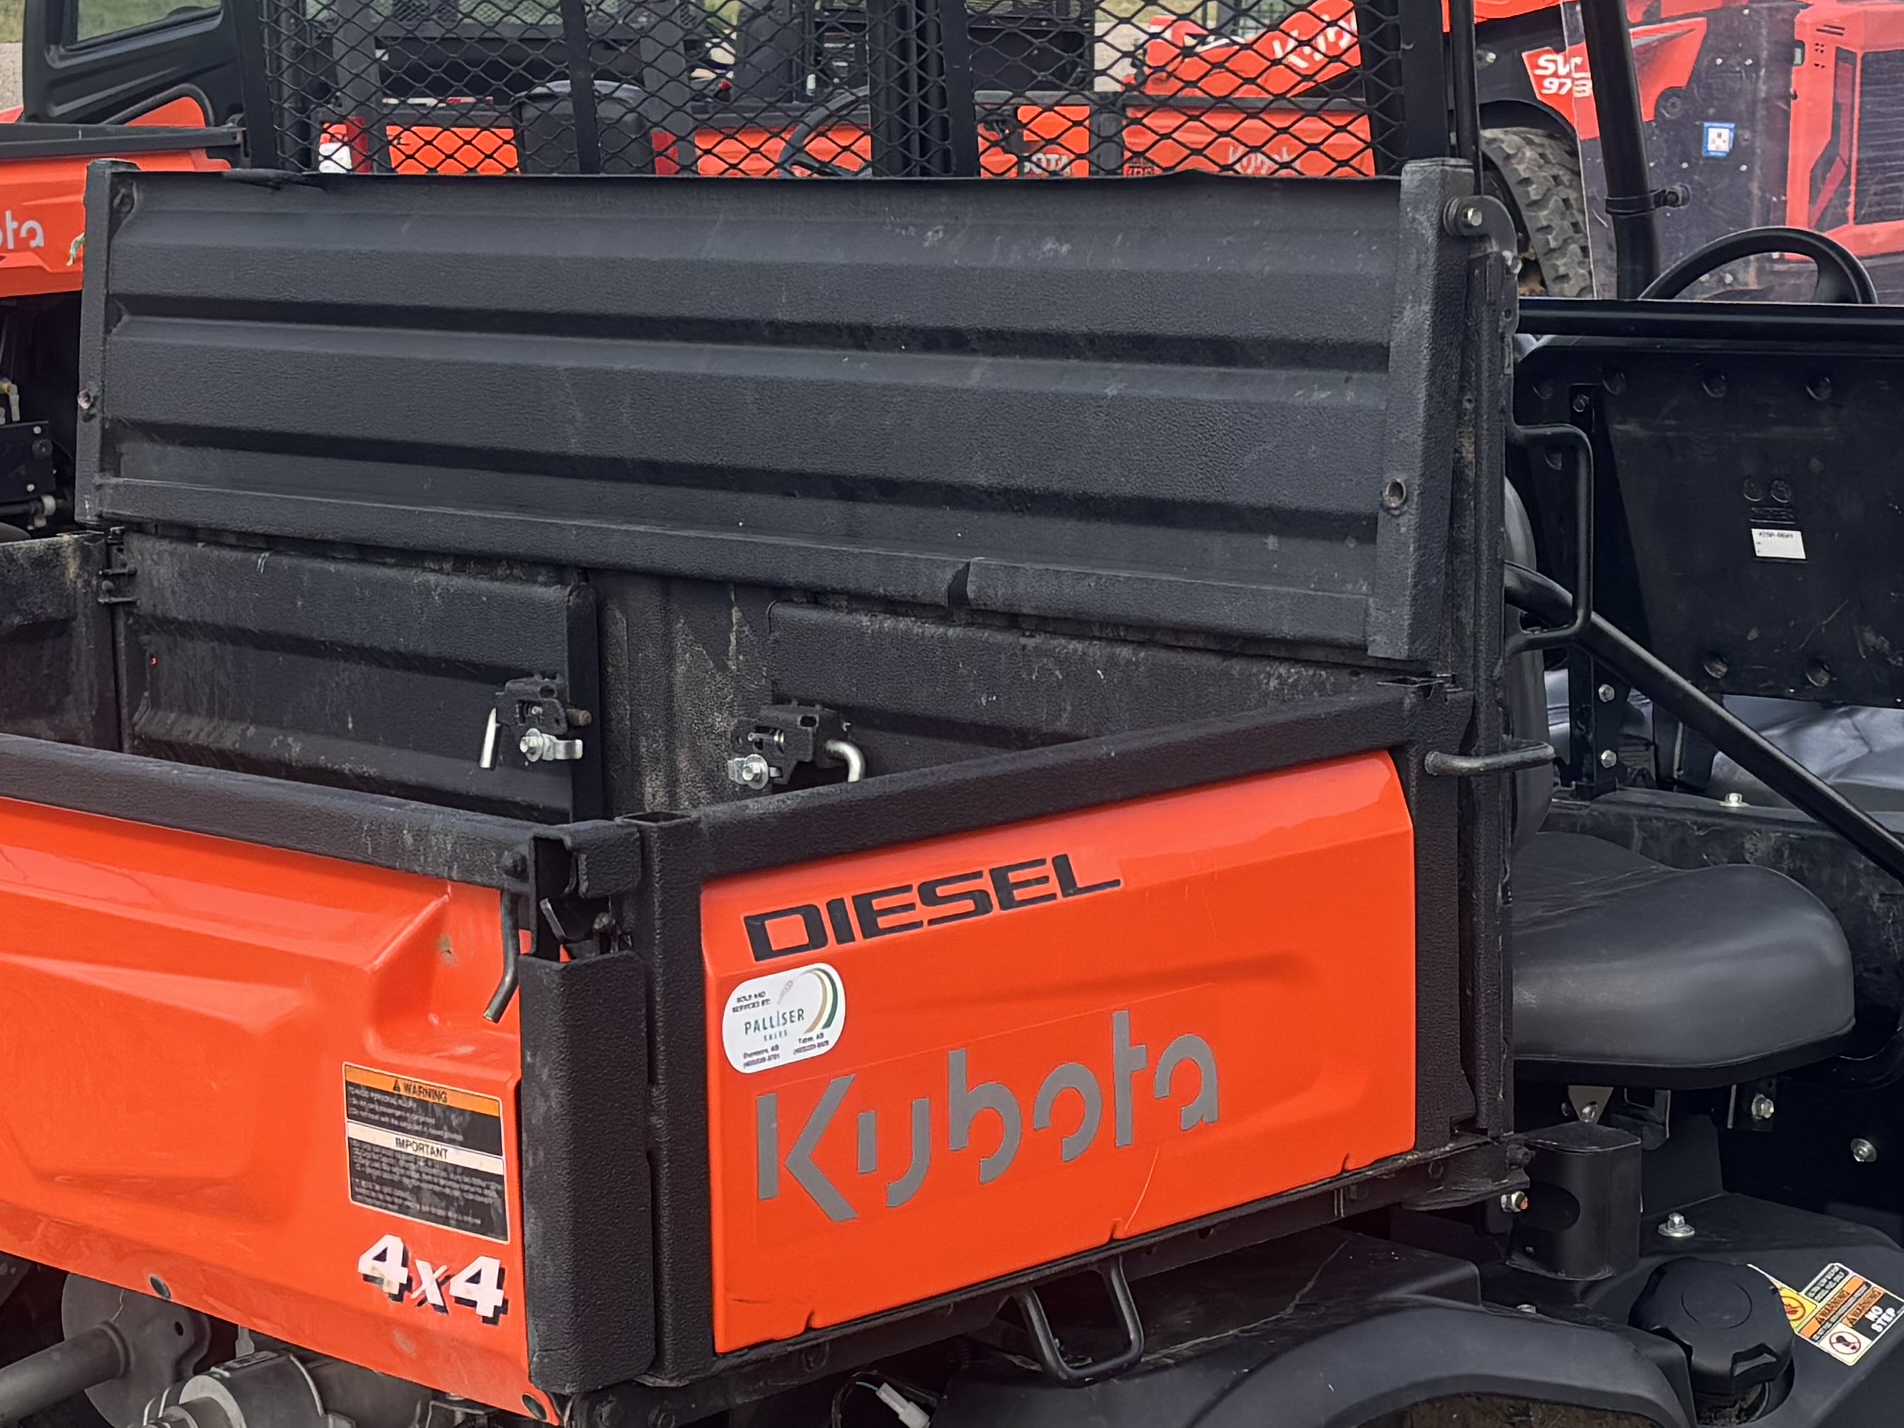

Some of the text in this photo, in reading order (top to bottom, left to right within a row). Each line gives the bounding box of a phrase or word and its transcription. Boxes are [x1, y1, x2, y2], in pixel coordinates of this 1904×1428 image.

[742, 853, 1122, 963] DIESEL
[744, 1008, 804, 1035] PALLISER
[402, 1082, 448, 1103] WARNING
[756, 1009, 1219, 1223] Kubota
[395, 1137, 449, 1160] IMPORTANT
[357, 1234, 508, 1325] 4x4
[1864, 1305, 1884, 1322] NO
[1870, 1307, 1897, 1333] STEP
